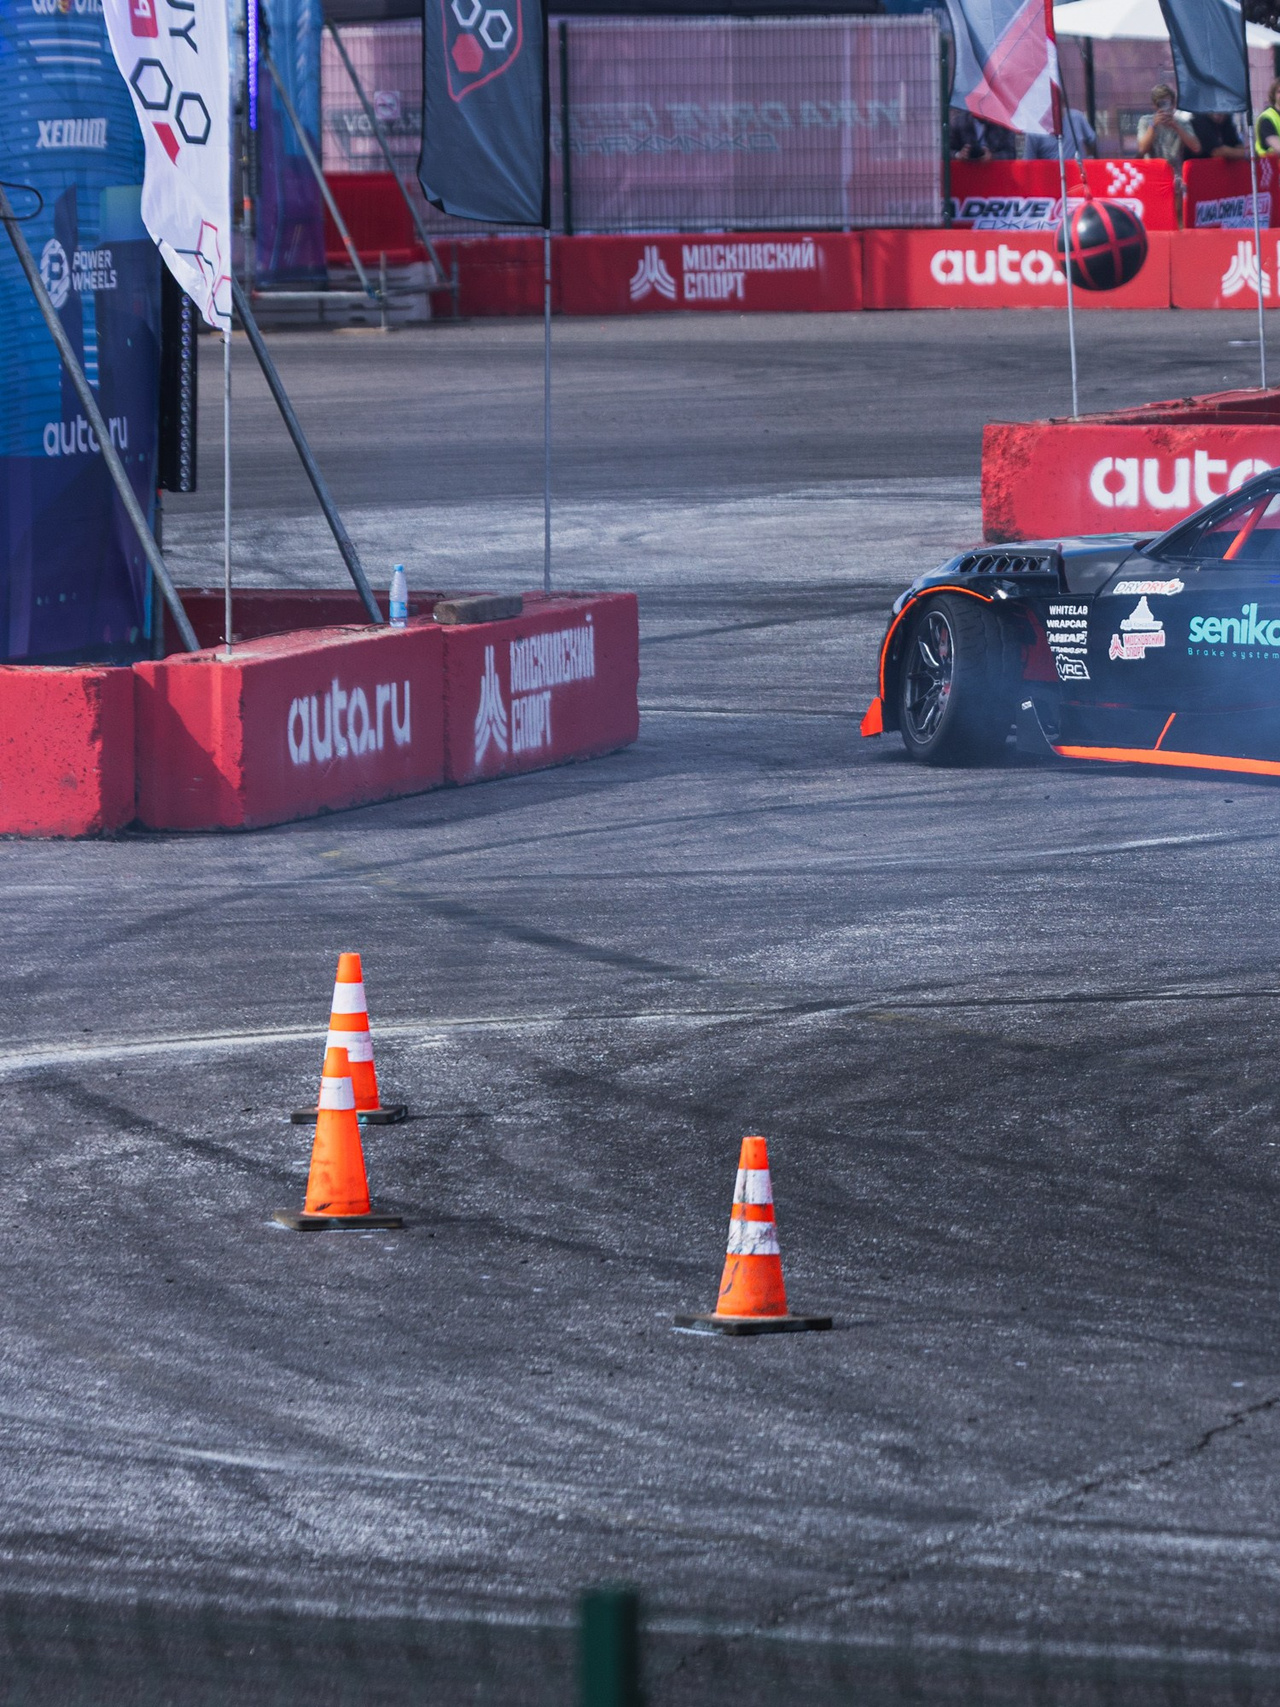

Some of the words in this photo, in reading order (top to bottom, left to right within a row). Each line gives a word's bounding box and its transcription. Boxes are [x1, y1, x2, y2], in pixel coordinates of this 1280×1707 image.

[36, 118, 107, 148] XENUM
[961, 199, 1046, 218] DRIVE
[72, 248, 113, 270] POWER
[682, 238, 815, 271] МОСКОВСКИЙ
[71, 269, 118, 290] WHEELS
[683, 273, 746, 300] СПОРТ
[43, 414, 128, 456] autoru
[1049, 605, 1088, 615] WHITELAB
[1046, 619, 1087, 628] WRAPCAR
[510, 614, 596, 693] МОСКОВСКИЙ
[1187, 647, 1225, 657] Brake
[1059, 663, 1084, 676] VRC
[288, 678, 411, 766] auto.ru
[511, 692, 552, 753] СПОРТ
